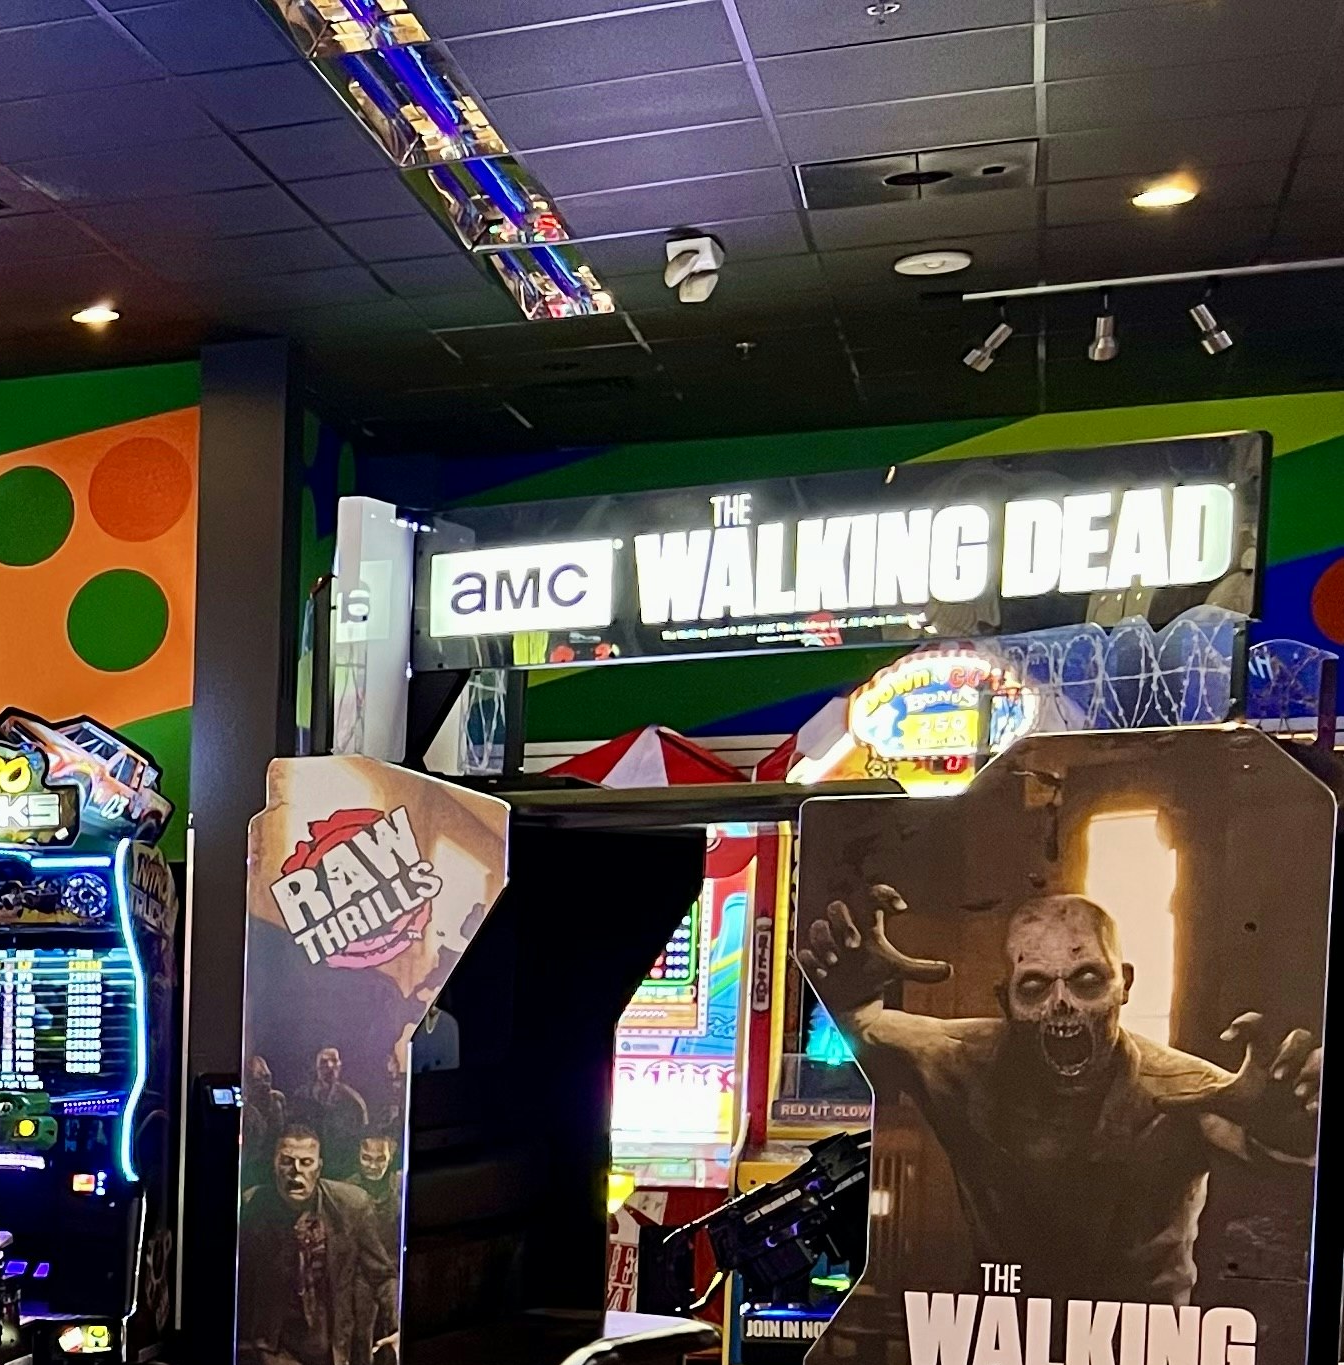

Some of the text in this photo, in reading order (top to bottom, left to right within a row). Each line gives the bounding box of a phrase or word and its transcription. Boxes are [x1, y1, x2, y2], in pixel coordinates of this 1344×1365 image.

[711, 494, 752, 527] THE
[634, 481, 1235, 626] WALKING DEAD
[269, 805, 419, 934] RAW
[292, 857, 444, 968] THRILLS
[781, 1104, 807, 1116] RED
[810, 1105, 830, 1117] LIT
[980, 1263, 1022, 1294] THE
[746, 1320, 800, 1338] JOIN IN
